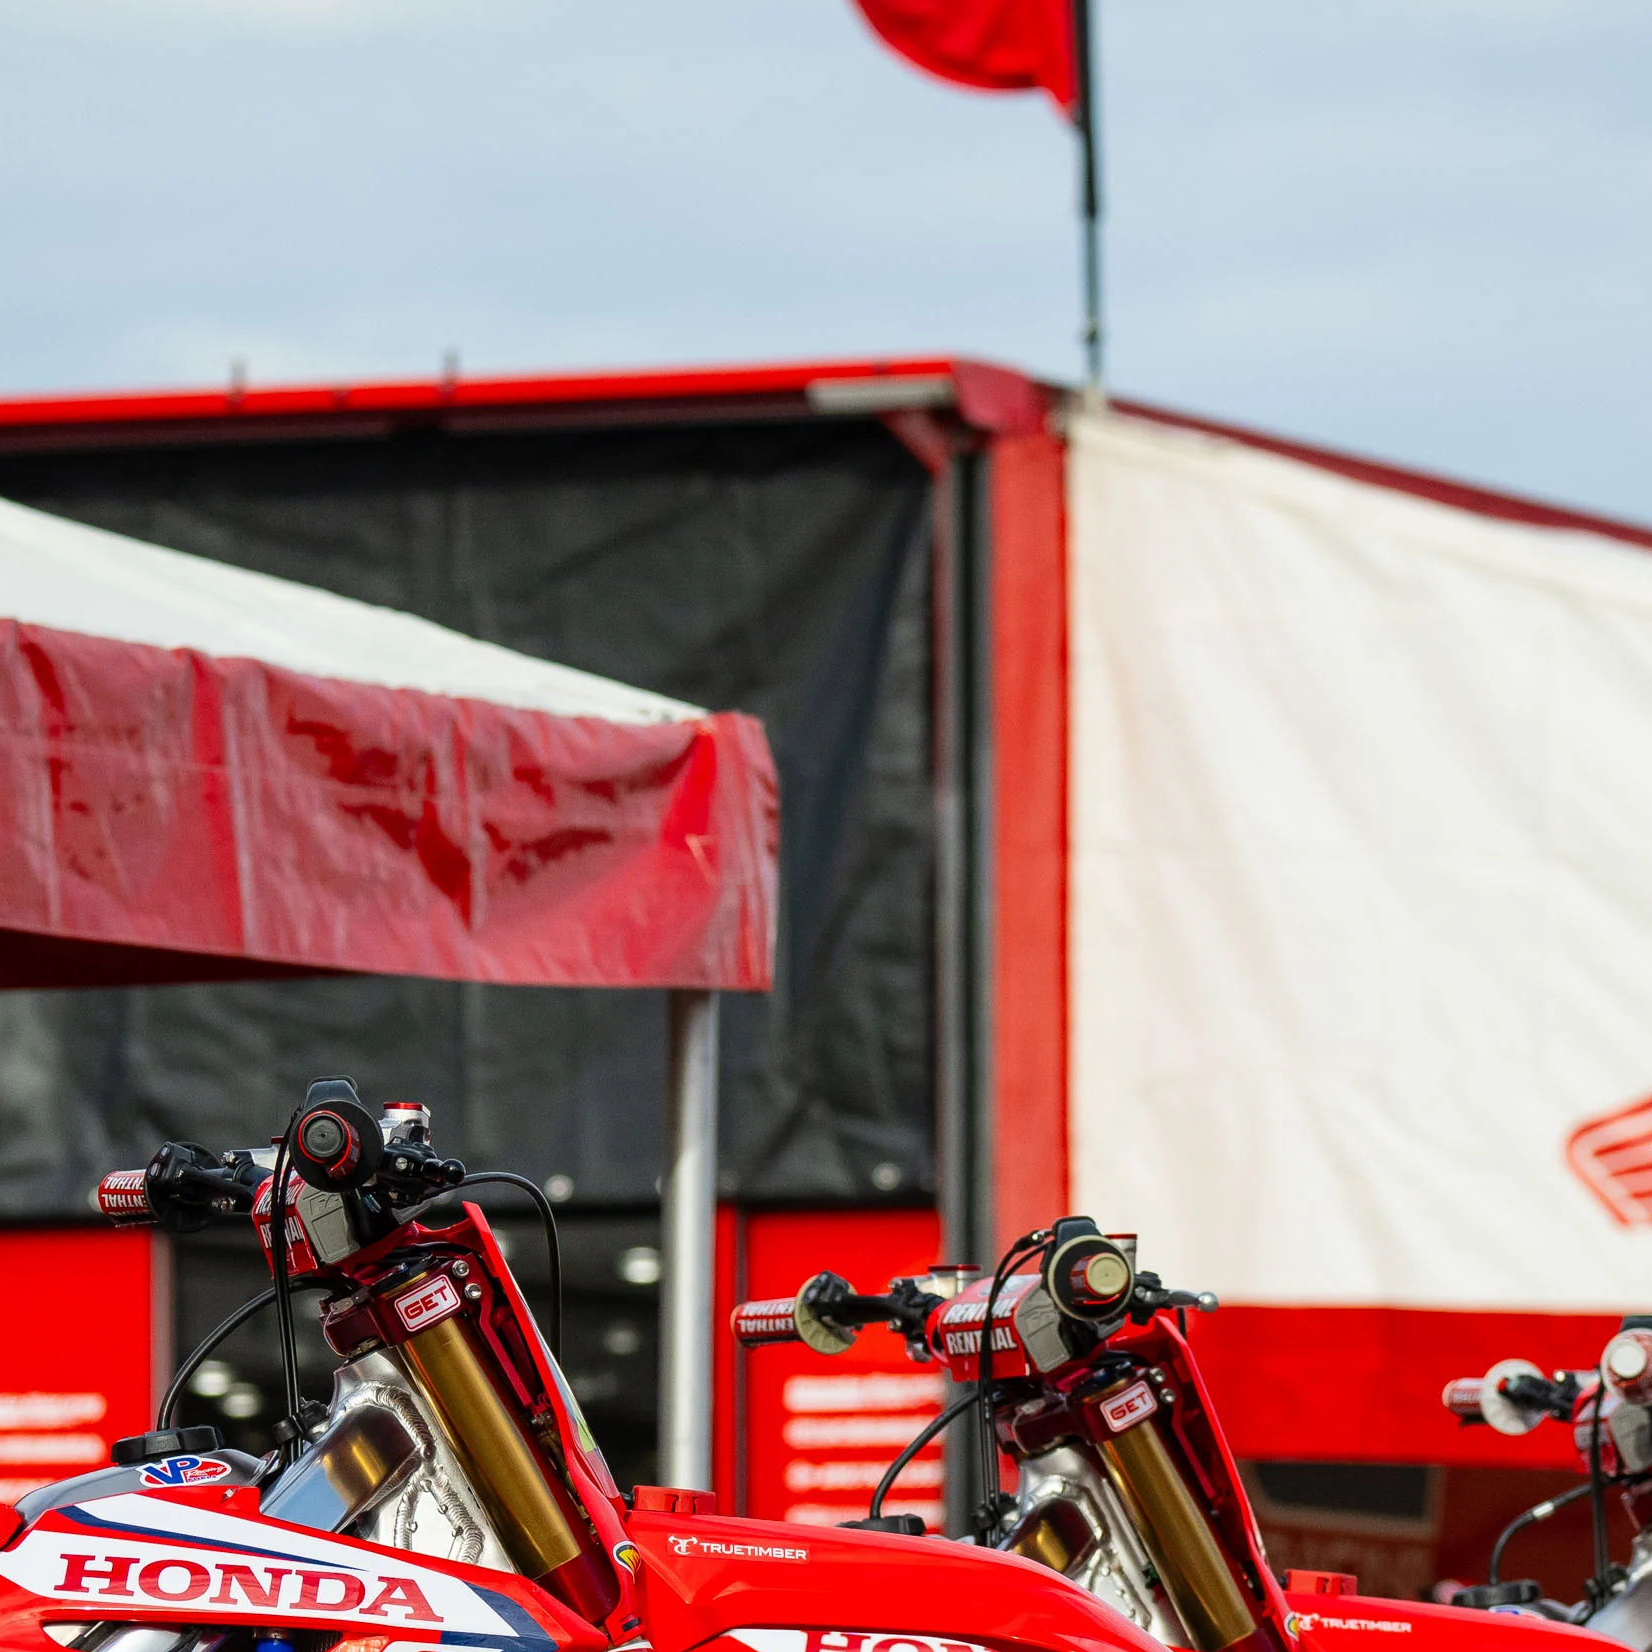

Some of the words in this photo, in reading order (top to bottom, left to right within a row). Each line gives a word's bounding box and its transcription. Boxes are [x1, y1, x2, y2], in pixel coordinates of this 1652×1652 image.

[405, 1284, 449, 1320] GET
[1110, 1391, 1147, 1421] GET
[143, 1457, 200, 1484] VP
[700, 1542, 807, 1560] TRUETIMBER
[54, 1554, 443, 1622] HONDA
